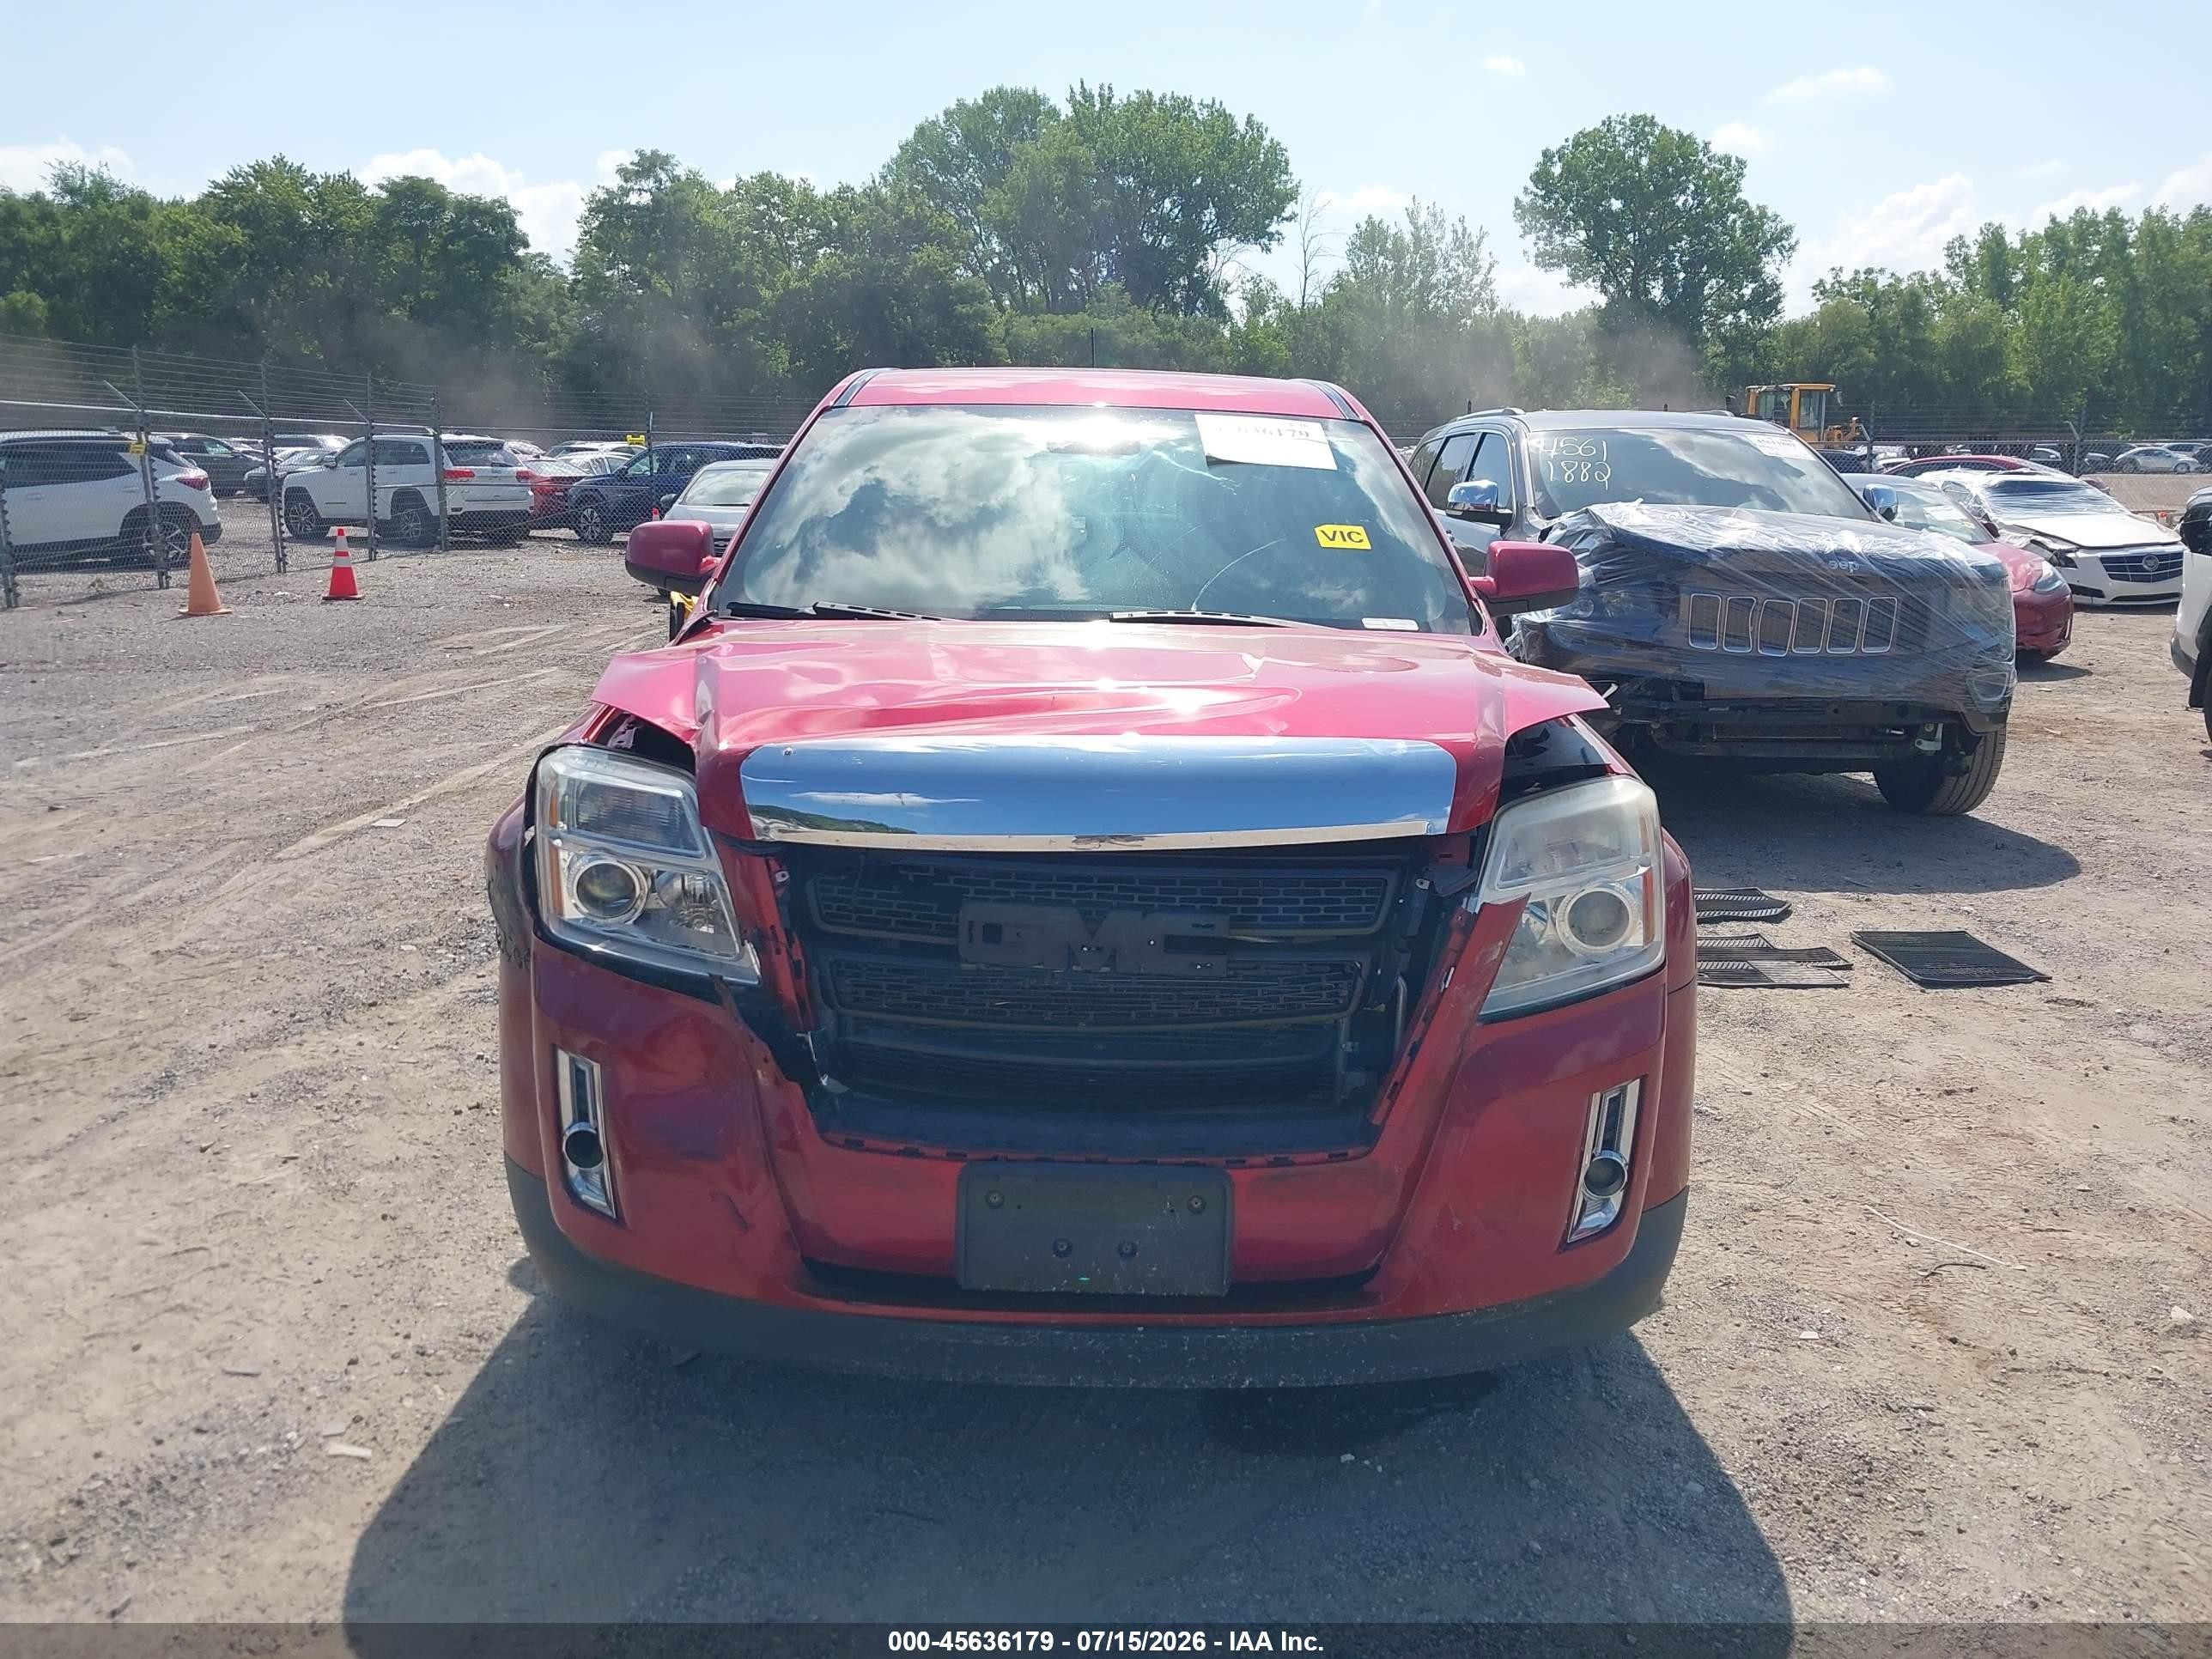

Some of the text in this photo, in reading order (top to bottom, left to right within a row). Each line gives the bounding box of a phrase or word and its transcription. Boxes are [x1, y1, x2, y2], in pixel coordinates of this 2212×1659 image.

[1540, 436, 1607, 462] 4561
[1547, 460, 1611, 491] 1882
[1319, 529, 1364, 543] VIC
[1827, 561, 1861, 573] eep
